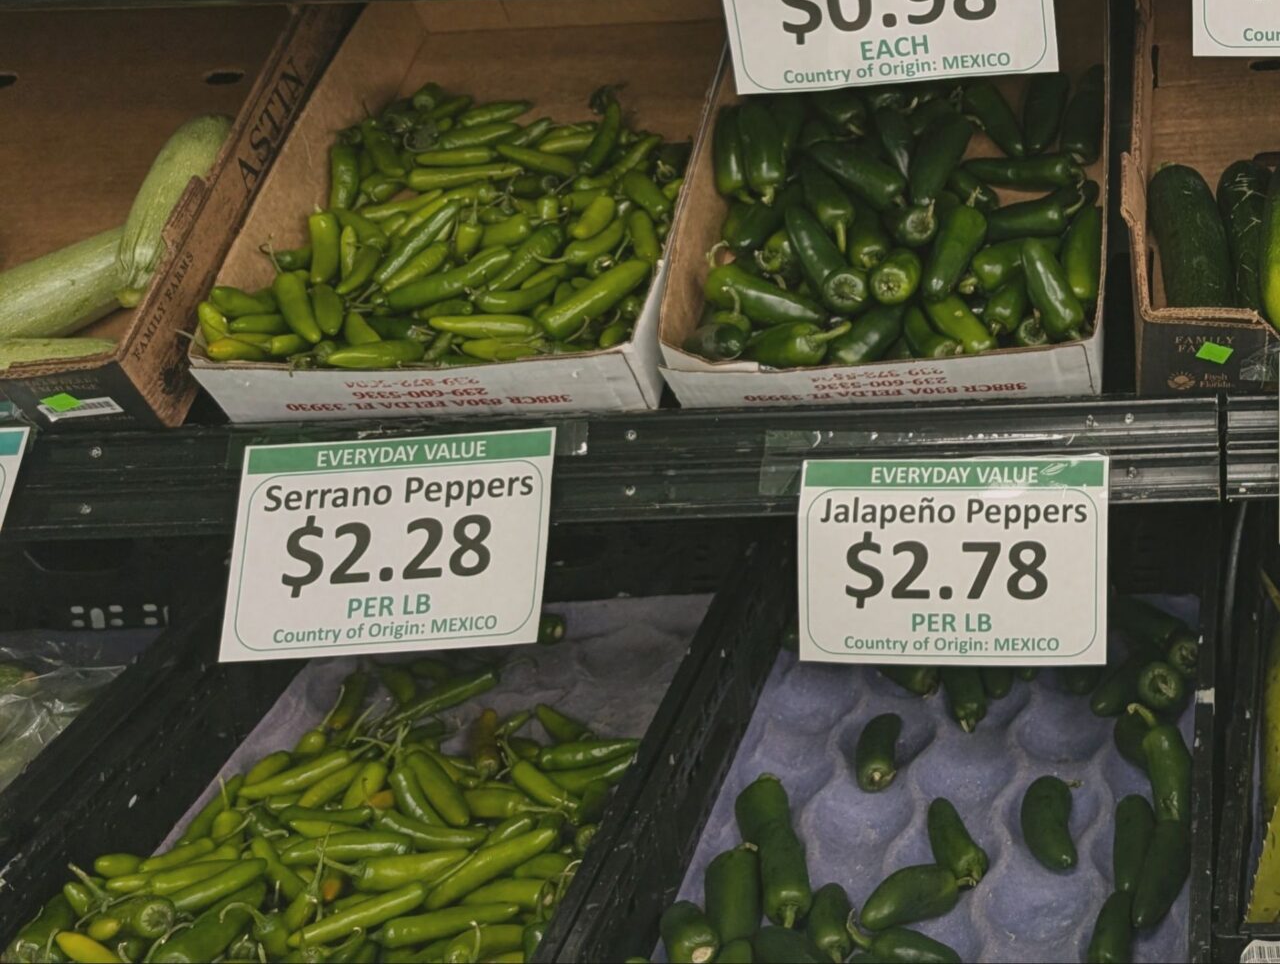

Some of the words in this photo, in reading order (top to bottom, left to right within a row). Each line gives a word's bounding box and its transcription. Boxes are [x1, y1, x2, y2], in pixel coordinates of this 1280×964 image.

[860, 35, 929, 61] EACH
[784, 67, 851, 85] Country
[856, 63, 875, 79] of
[879, 59, 937, 79] Origin:
[942, 52, 1011, 70] MEXICO
[235, 55, 308, 198] ASTIN
[133, 297, 168, 361] FAMILY
[164, 251, 195, 302] FARMS
[377, 399, 446, 410] FELDA
[316, 445, 418, 468] EVERYDAY
[424, 440, 487, 461] VALUE
[871, 467, 971, 484] EVERYDAY
[976, 467, 1039, 484] VALUE
[263, 484, 392, 513] Serrano
[404, 475, 534, 508] Peppers
[820, 497, 956, 529] Jalapeño
[967, 498, 1088, 529] Peppers
[281, 514, 492, 599] $2.28
[845, 531, 1048, 609] $2.78
[347, 596, 394, 619] PER
[402, 594, 431, 615] LB
[273, 626, 342, 644] Country
[346, 624, 365, 640] of
[369, 621, 426, 640] Origin:
[430, 615, 497, 634] MEXICO
[911, 613, 957, 633] PER
[965, 613, 992, 633] LB
[844, 636, 908, 653] Country
[912, 636, 931, 651] of
[934, 636, 990, 654] Origin:
[994, 637, 1060, 652] MEXICO
